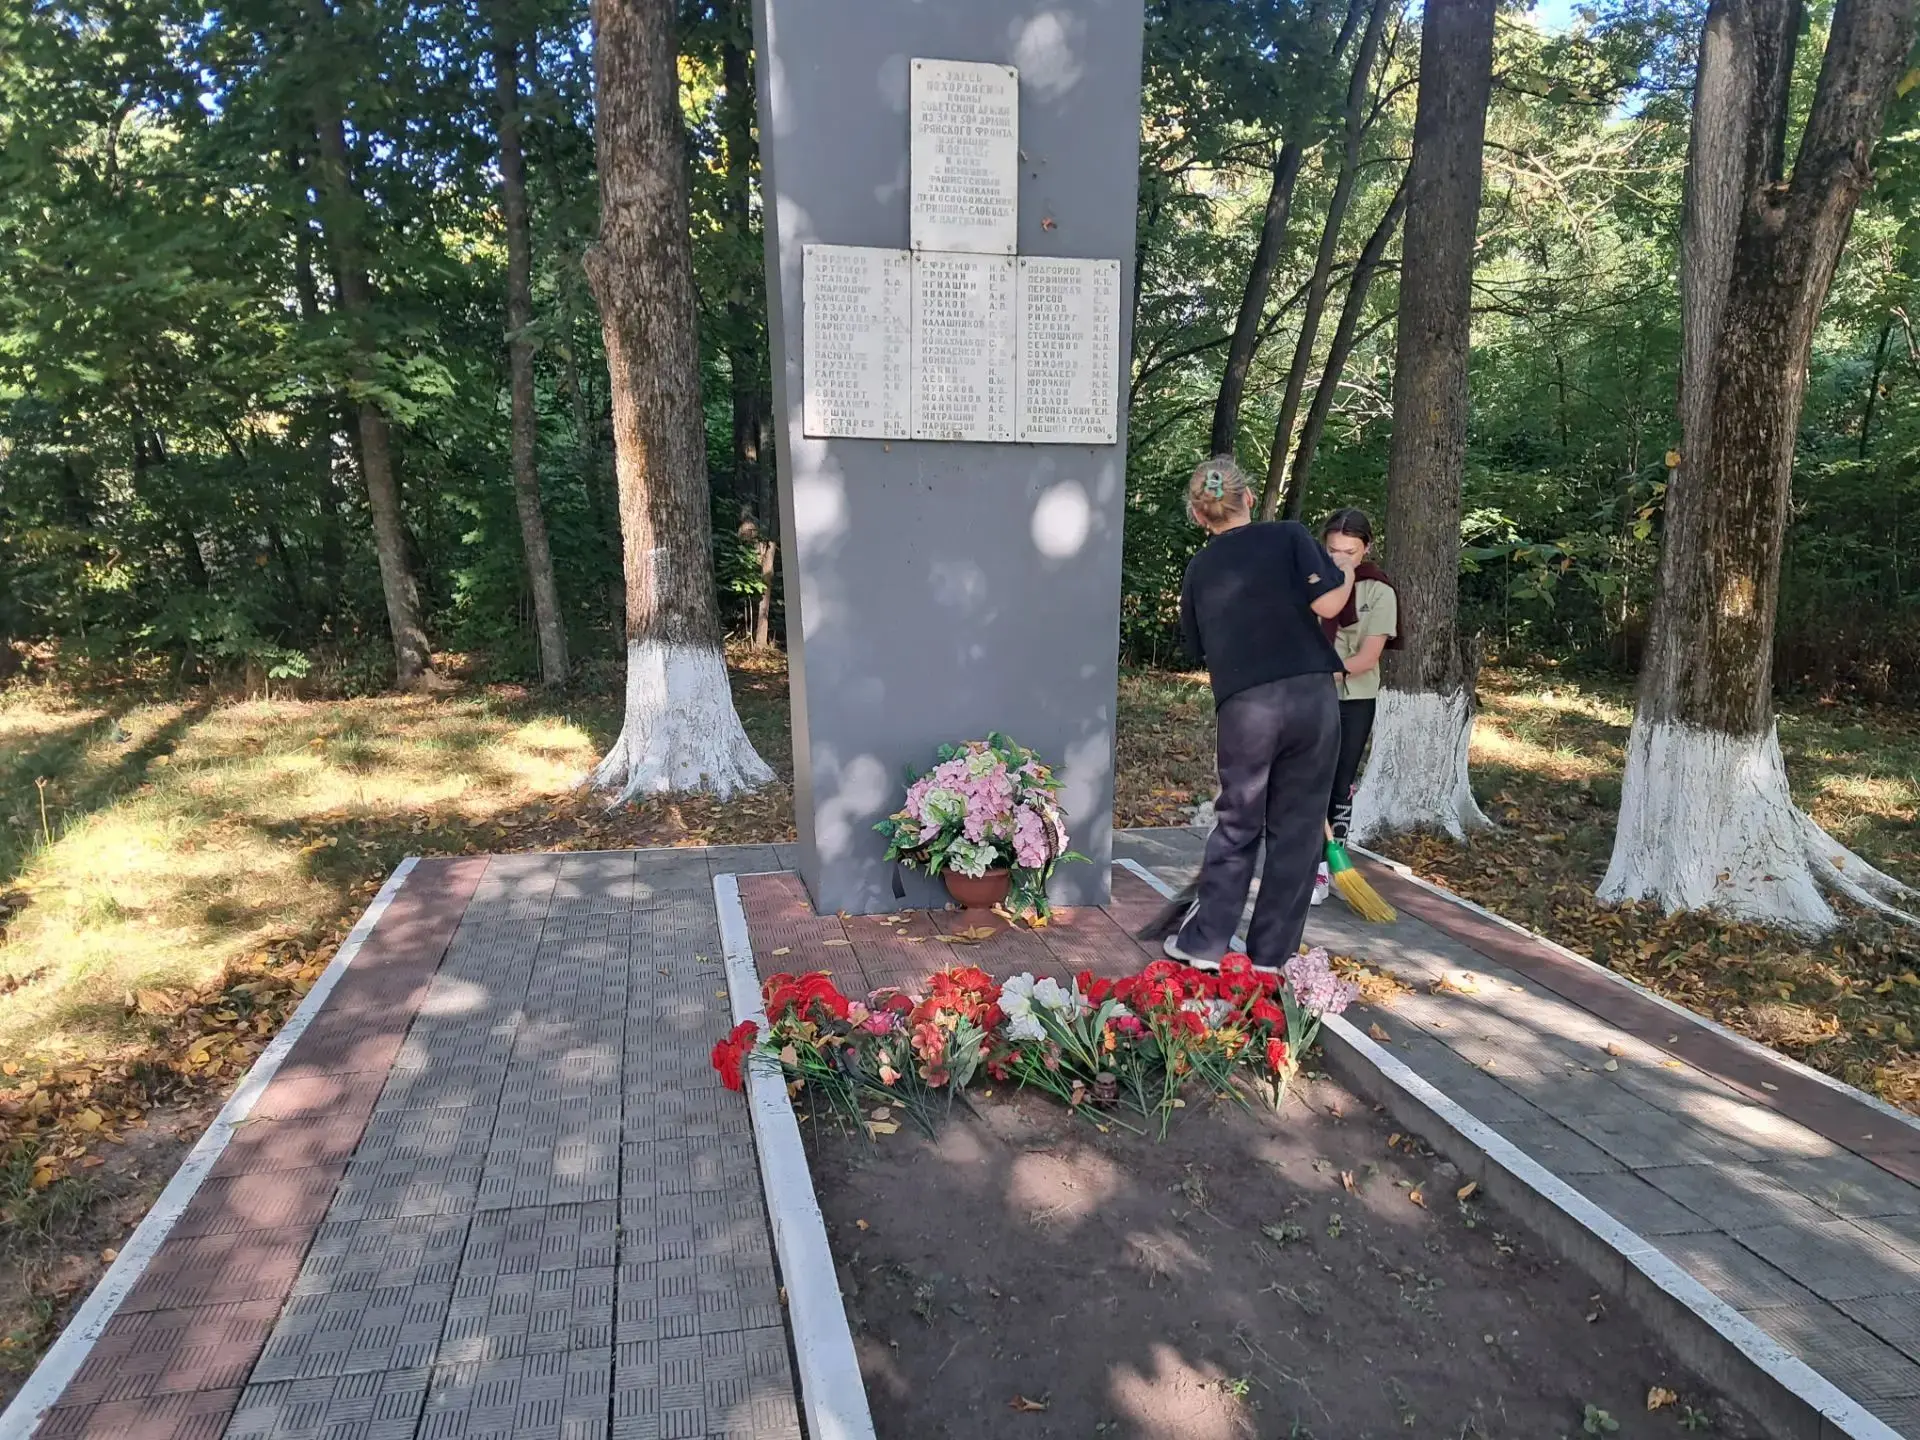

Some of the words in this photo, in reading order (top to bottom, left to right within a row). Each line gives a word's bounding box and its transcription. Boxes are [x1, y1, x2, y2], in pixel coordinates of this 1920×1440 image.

[922, 261, 977, 271] ЕФРЕМОВ
[1028, 304, 1066, 312] РЫЖОВ
[922, 319, 985, 328] КАЛАШНИКОВ
[922, 394, 981, 403] МОЛЧАНОВ
[1027, 407, 1090, 415] КОНОПЕЛЬКИН
